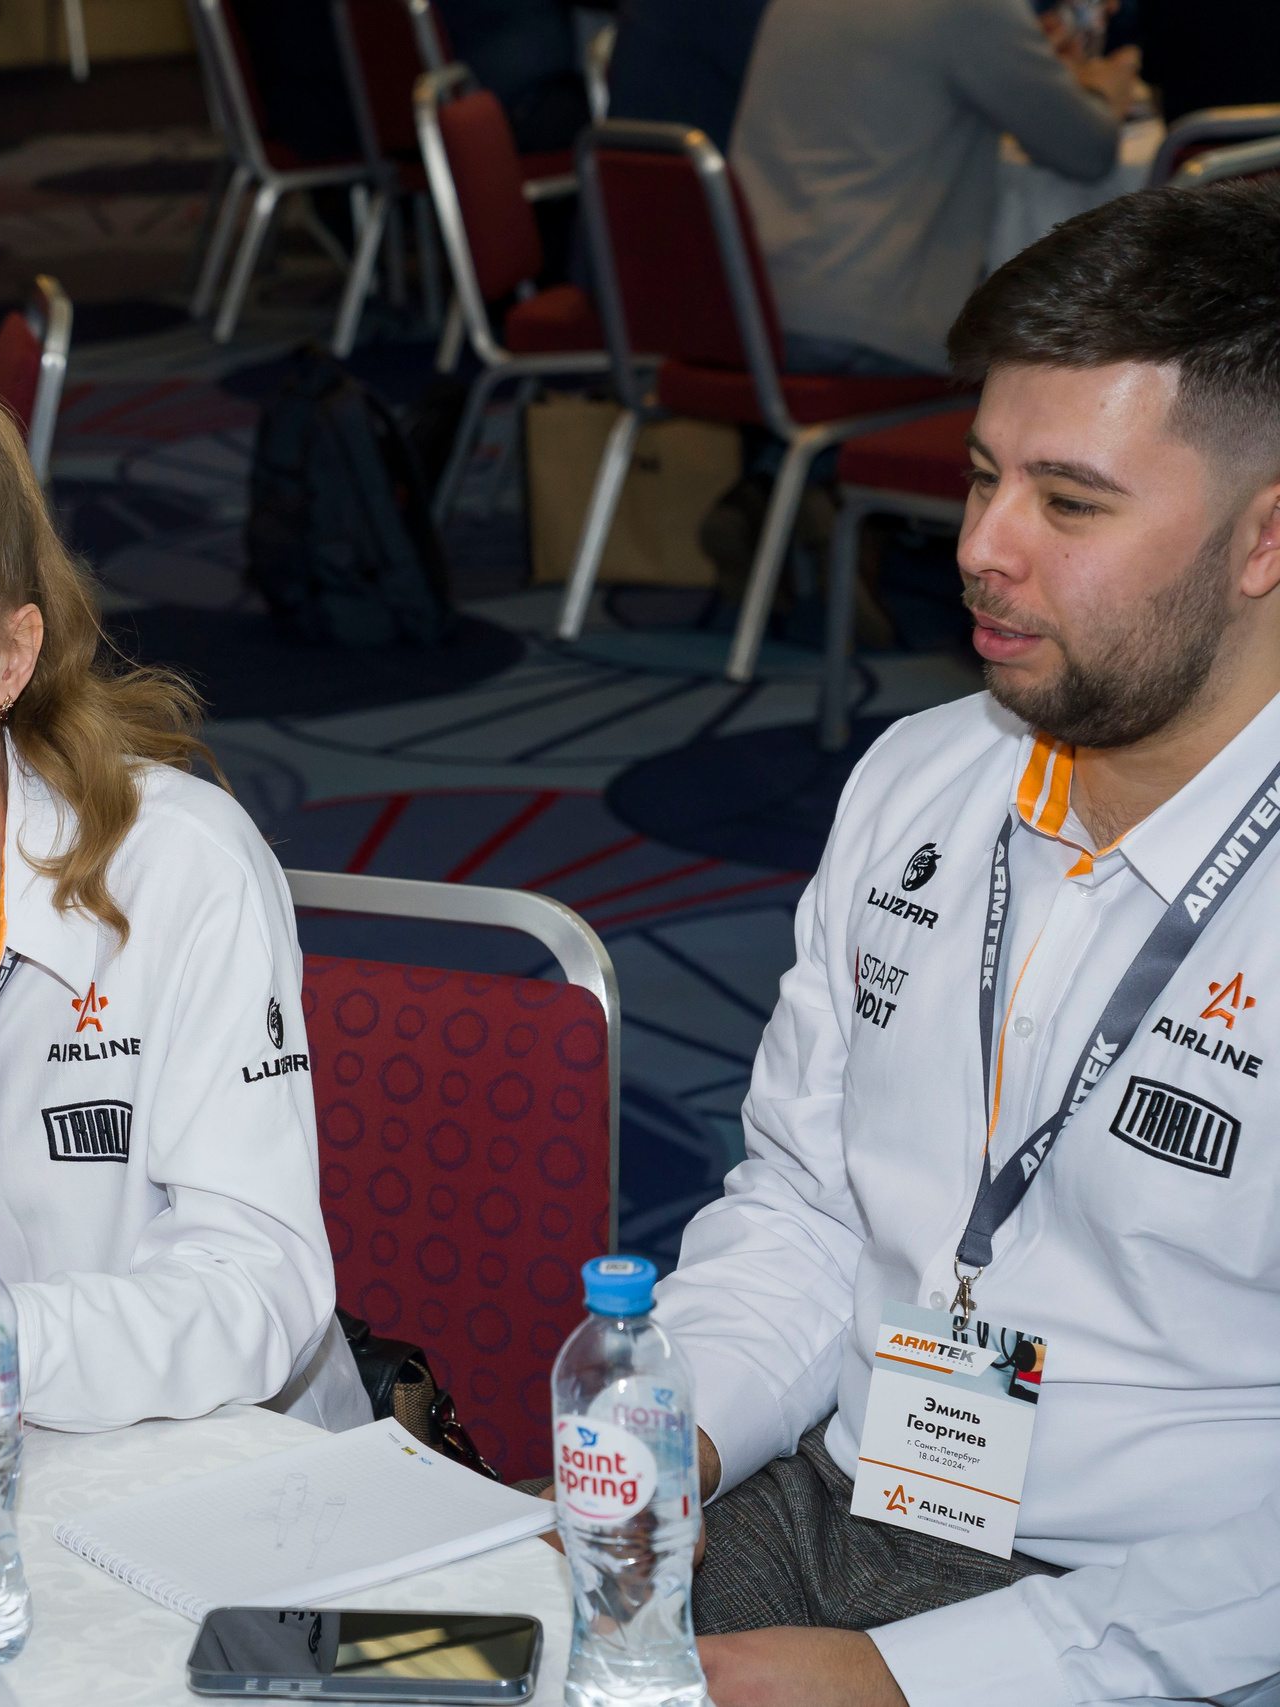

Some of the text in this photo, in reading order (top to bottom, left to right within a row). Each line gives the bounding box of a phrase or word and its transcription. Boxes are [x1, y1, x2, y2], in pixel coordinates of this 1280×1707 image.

[867, 887, 939, 929] LUZAR
[982, 840, 1007, 991] ARMTEK
[861, 953, 909, 996] START
[856, 985, 897, 1029] VOLT
[47, 1037, 141, 1062] AIRLINE
[1151, 1016, 1263, 1079] AIRLINE
[1125, 1087, 1227, 1166] TRIALLI
[889, 1333, 977, 1364] ARMTEK
[924, 1397, 981, 1425] Эмиль
[906, 1413, 987, 1448] Георгиев
[561, 1445, 627, 1474] saint
[914, 1439, 981, 1465] Санкт-Петербург
[918, 1451, 967, 1472] 18.04.2024г.
[559, 1465, 637, 1506] spring
[919, 1500, 986, 1529] AIRLINE
